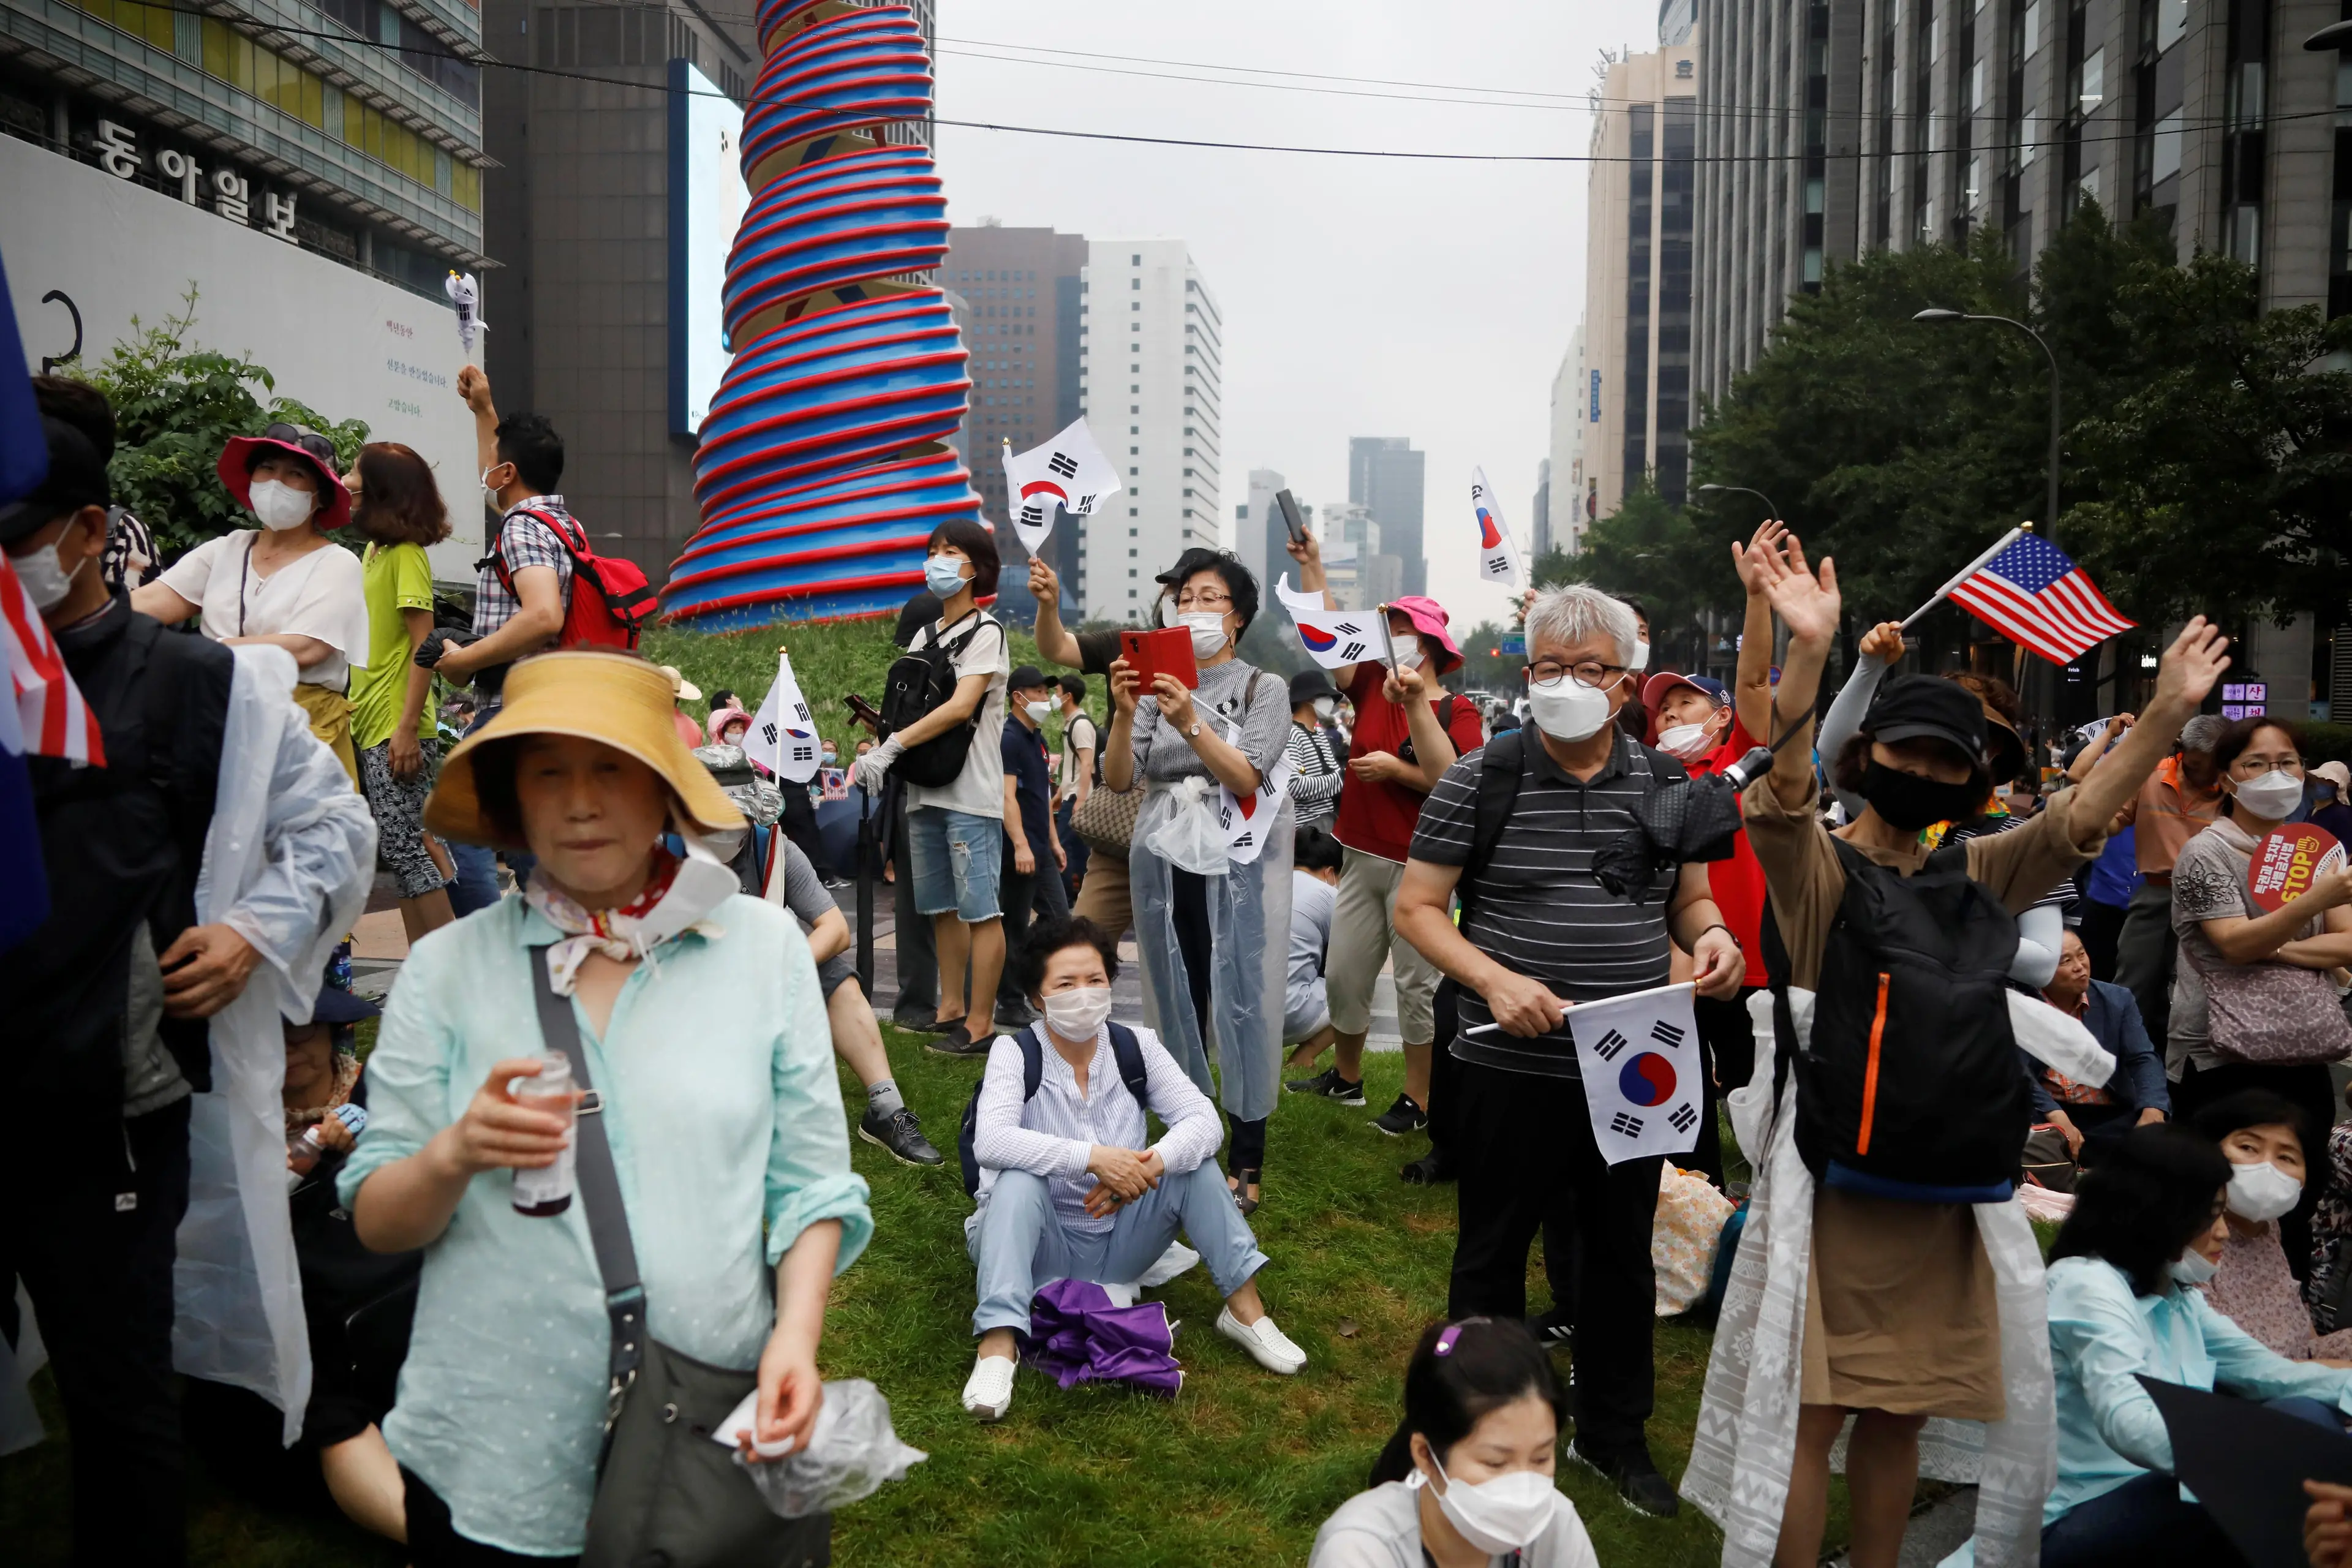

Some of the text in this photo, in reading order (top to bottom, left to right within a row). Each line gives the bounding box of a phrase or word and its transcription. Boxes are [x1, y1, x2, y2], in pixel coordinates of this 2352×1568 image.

[92, 119, 298, 244] 동아일보
[387, 358, 448, 388] 신문을 만들었습니다.
[388, 398, 423, 418] 고맙습니다.
[2249, 685, 2262, 699] 산
[2254, 834, 2284, 894] 특권과 역차별
[2269, 842, 2295, 891] 차별금지법
[2280, 851, 2313, 903] STOP
[870, 1087, 892, 1098] FILA
